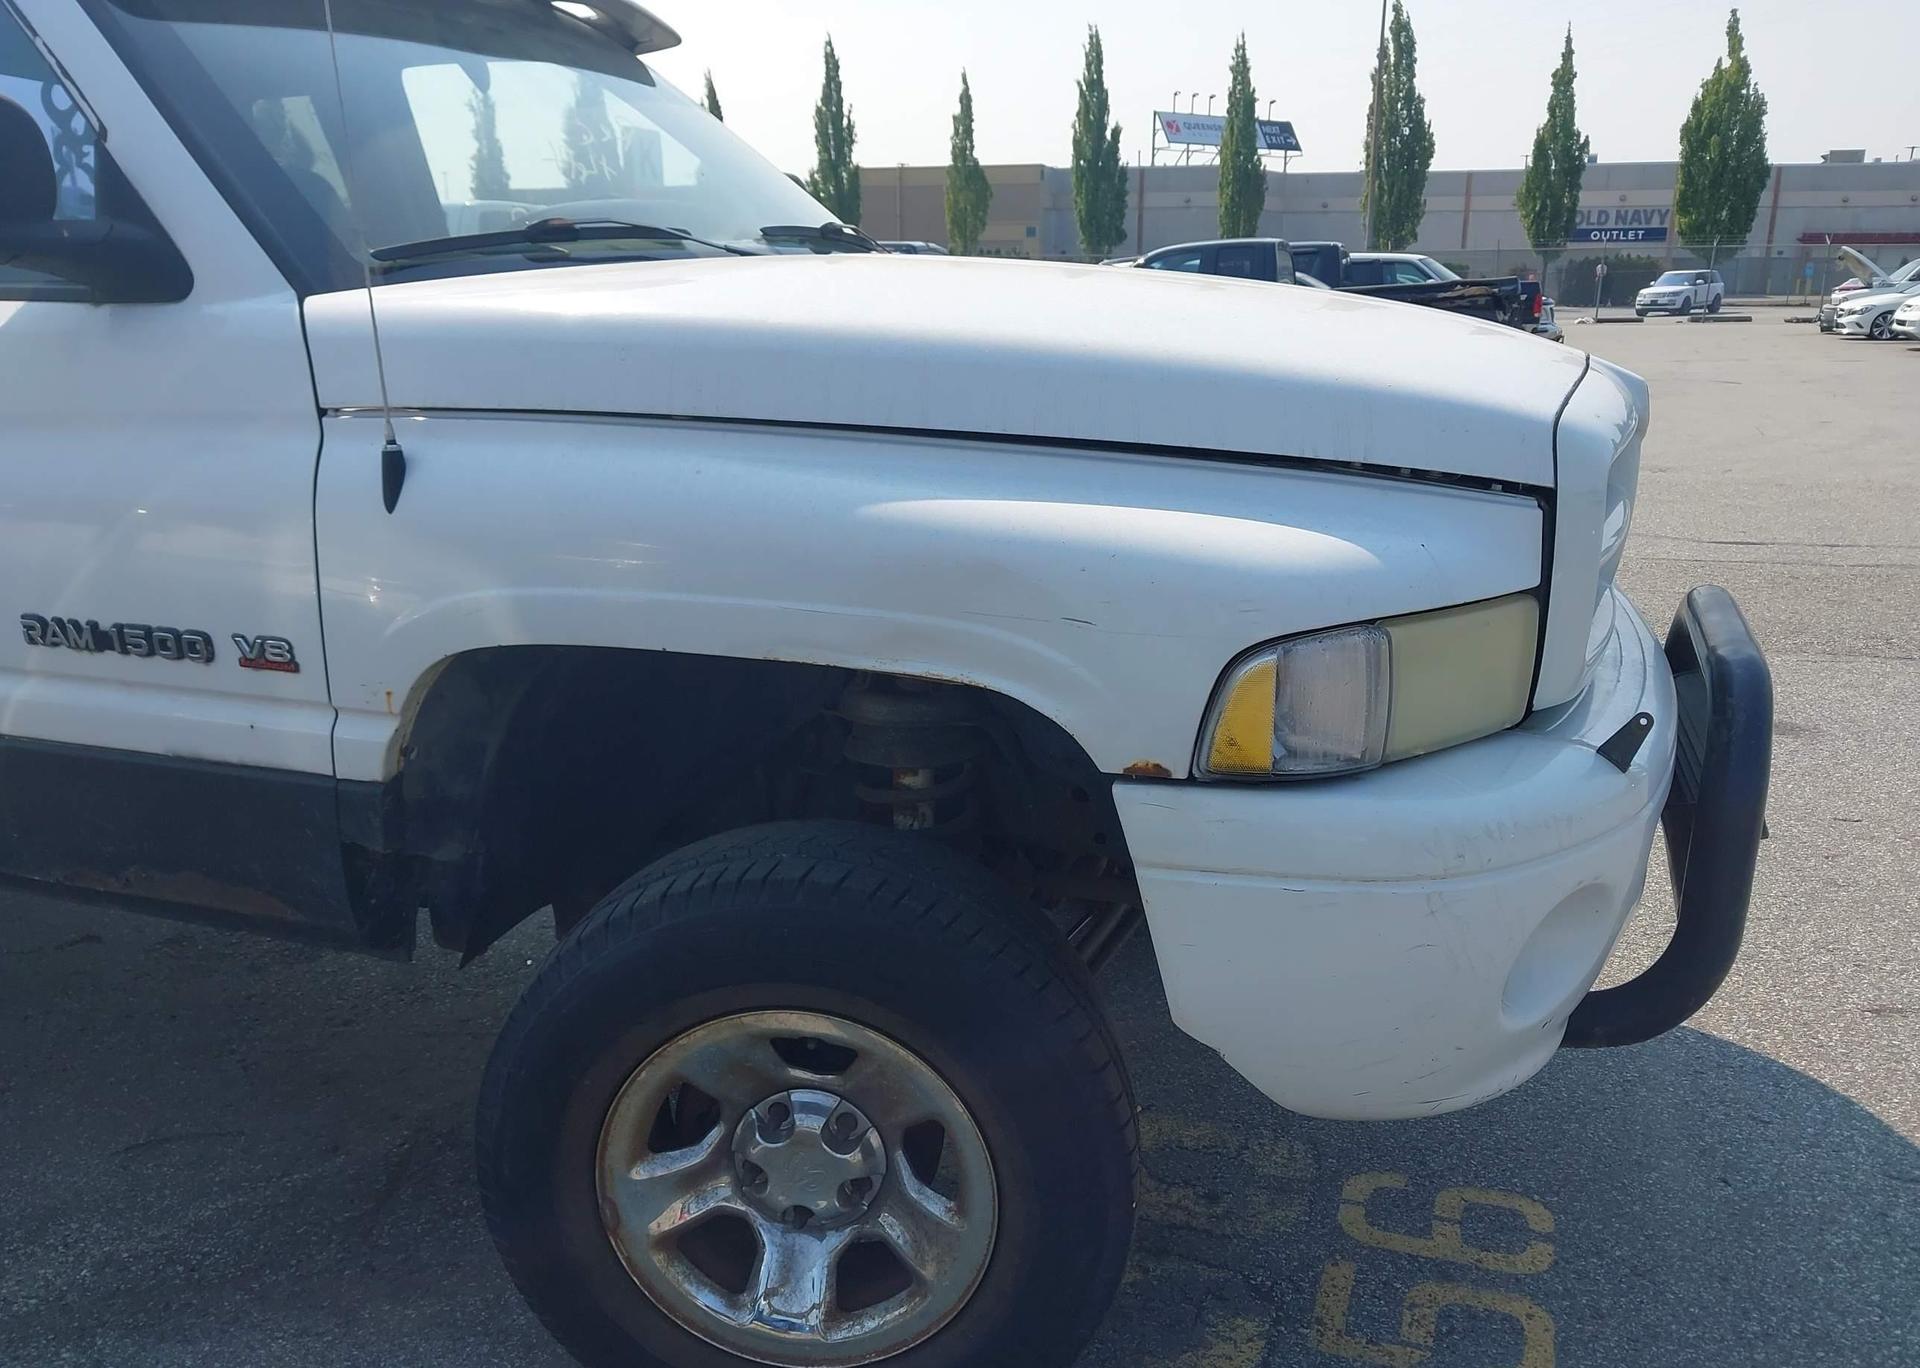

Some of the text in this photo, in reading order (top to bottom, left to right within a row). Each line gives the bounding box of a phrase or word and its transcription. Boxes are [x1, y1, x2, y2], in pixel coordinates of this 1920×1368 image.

[1261, 125, 1281, 135] NEXT
[1265, 135, 1286, 144] EXIT
[1614, 208, 1670, 226] NAVY
[1590, 230, 1645, 241] OUTLET
[20, 613, 215, 664] RAM 1500
[231, 632, 298, 664] V8
